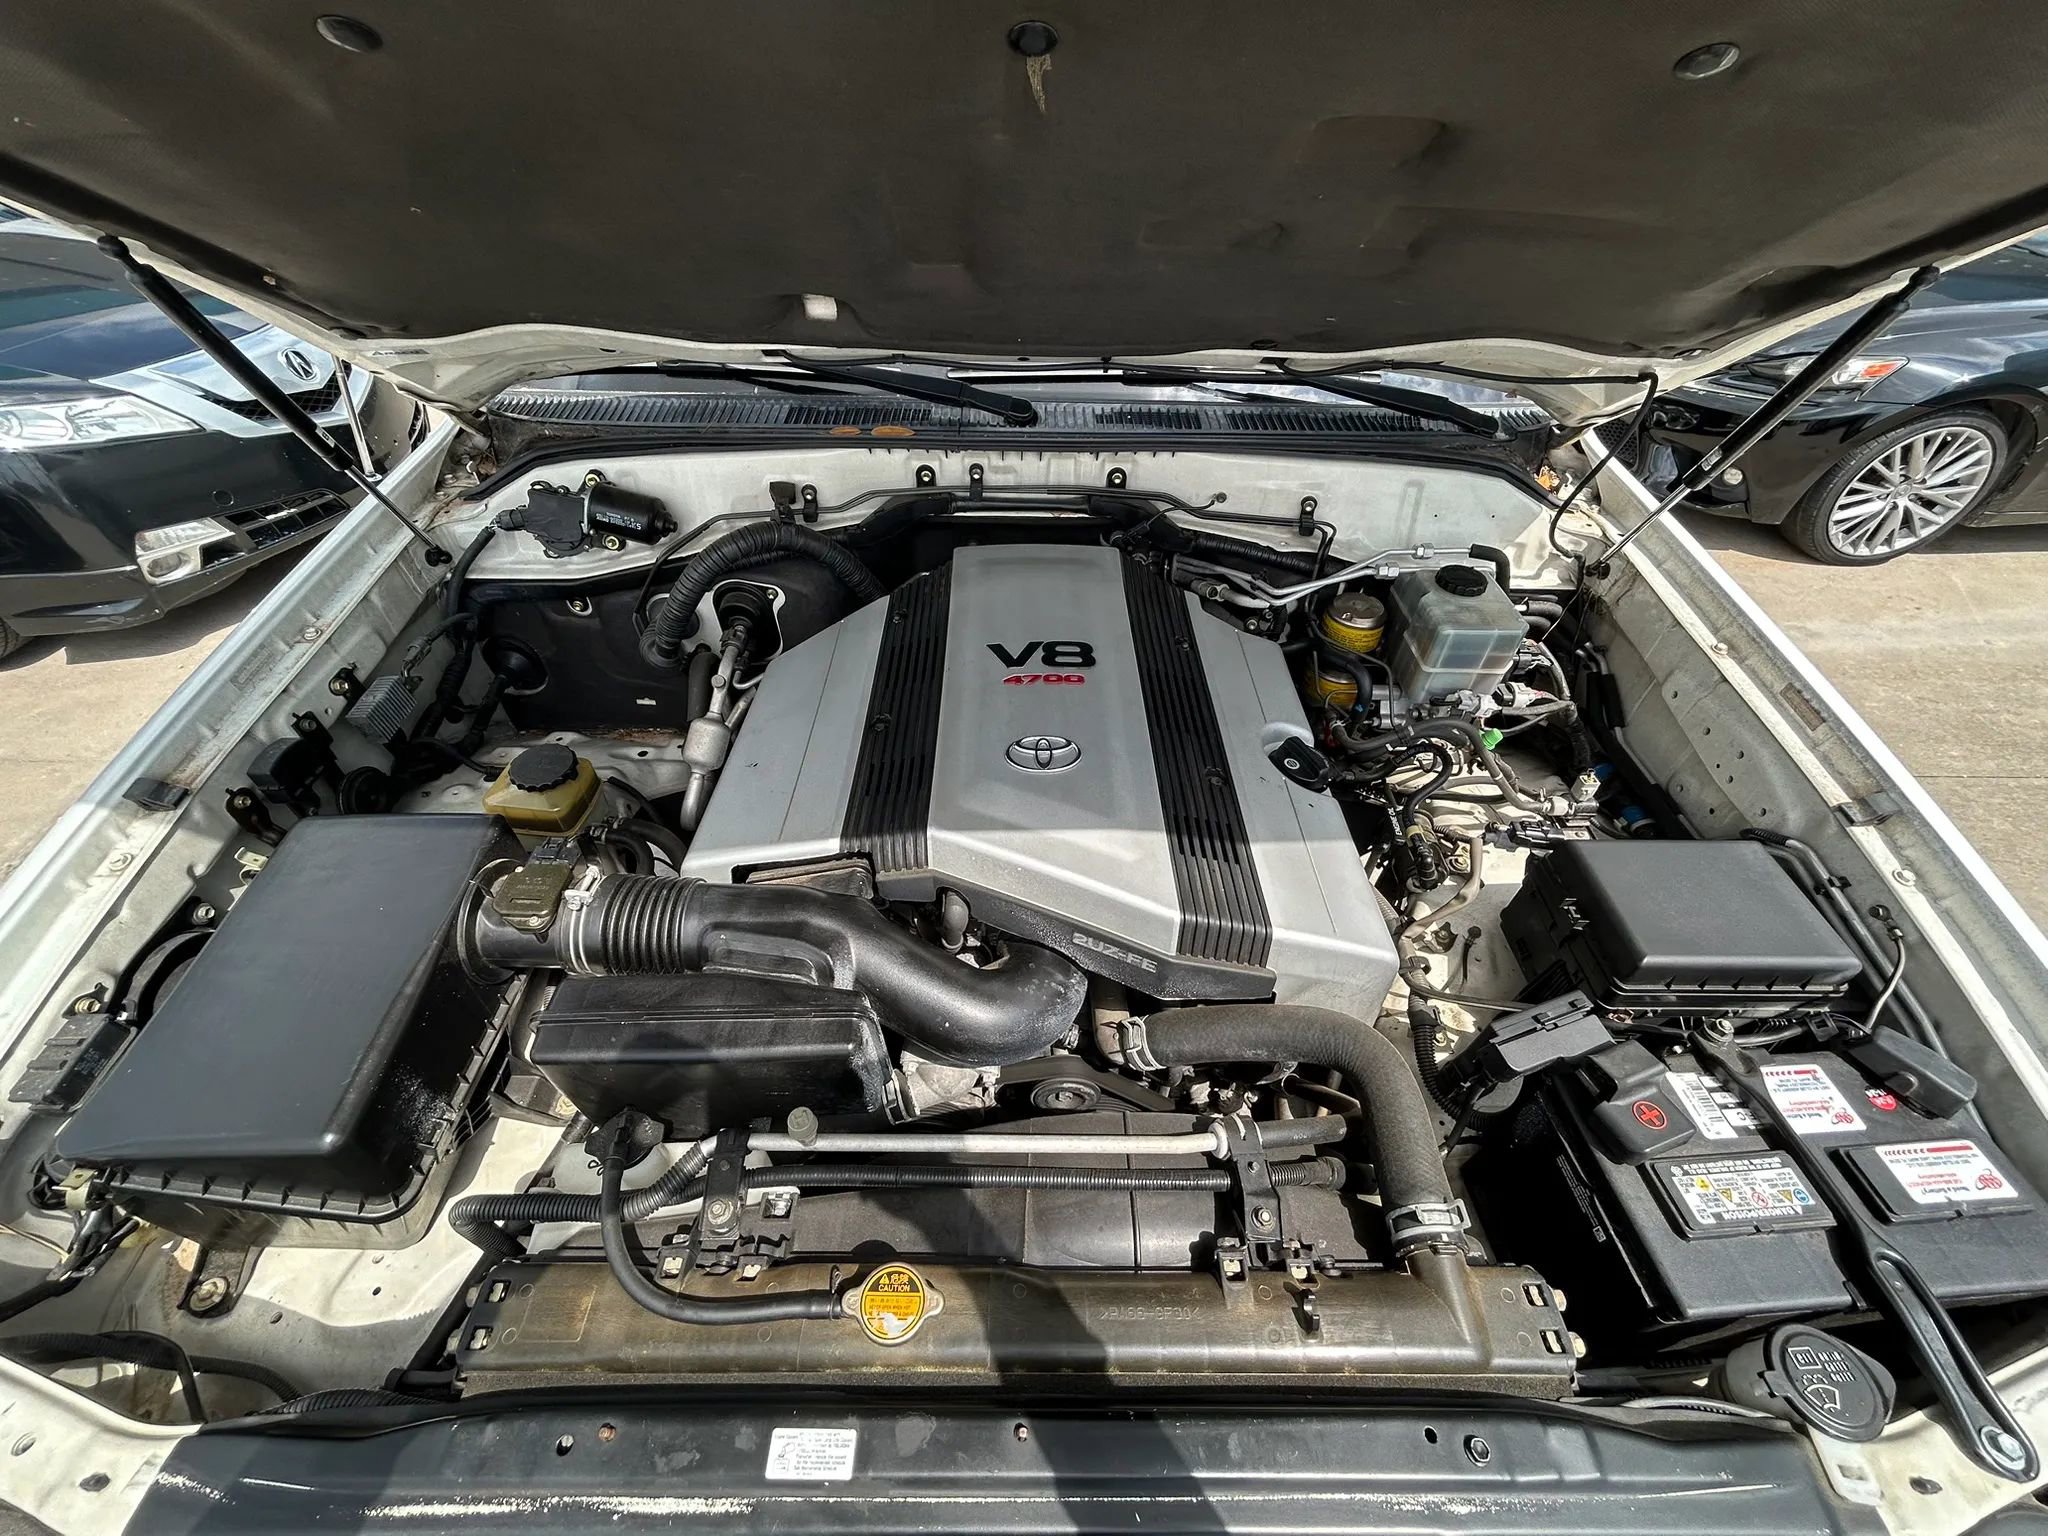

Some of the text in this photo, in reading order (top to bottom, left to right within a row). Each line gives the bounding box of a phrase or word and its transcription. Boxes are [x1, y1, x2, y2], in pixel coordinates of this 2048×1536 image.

[986, 640, 1096, 669] V8
[1003, 673, 1086, 686] 4700
[1072, 932, 1158, 974] 2UZ-FE
[878, 1284, 911, 1292] CAUTION
